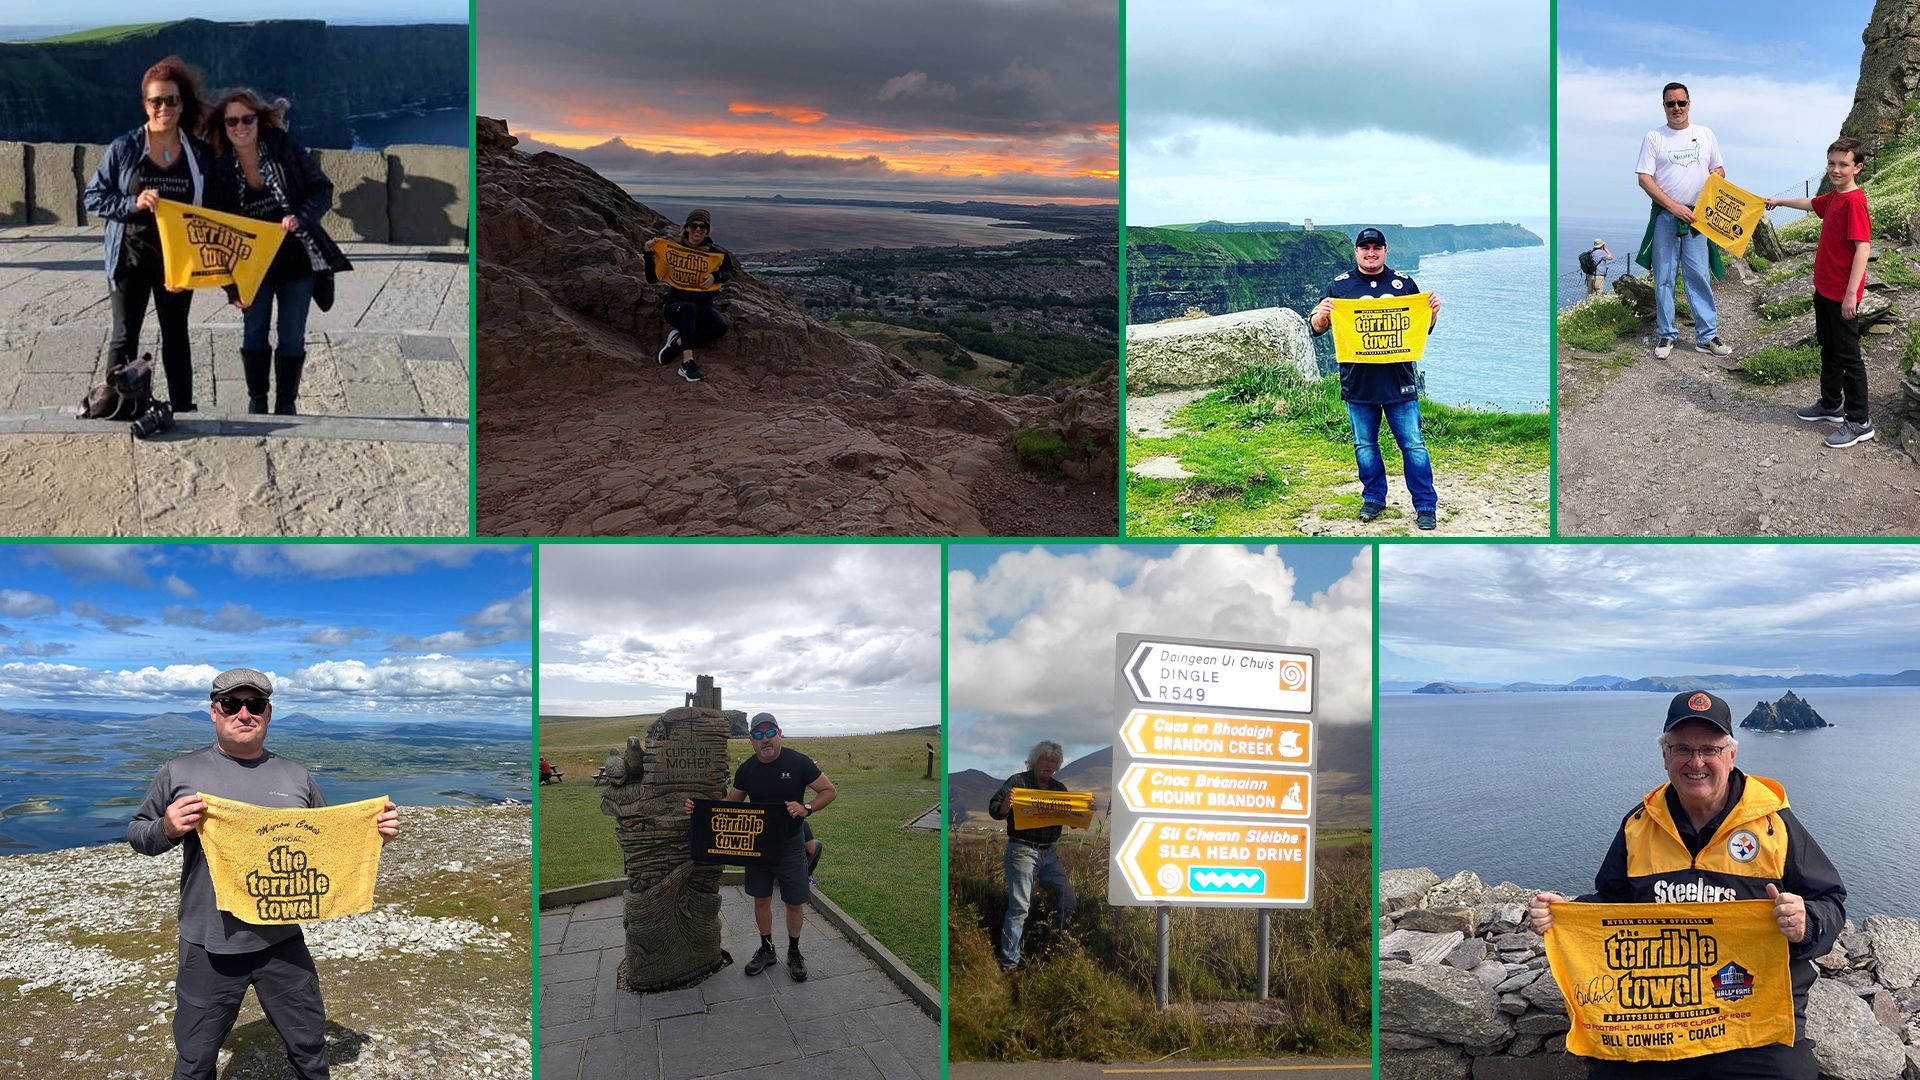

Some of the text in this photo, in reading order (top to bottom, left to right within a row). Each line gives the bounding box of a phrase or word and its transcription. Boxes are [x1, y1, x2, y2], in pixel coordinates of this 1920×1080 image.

[666, 250, 709, 273] terrible
[1355, 313, 1410, 334] terrible
[1362, 329, 1403, 350] towel
[1160, 650, 1217, 666] Daingean
[1160, 668, 1220, 683] DINGLE
[1153, 718, 1273, 740] Cuas an Bhodaigh
[666, 747, 711, 758] CLIFFS OF
[1154, 736, 1274, 756] BRANDON CREEK
[666, 757, 711, 769] MOHER
[1151, 771, 1190, 787] Cnoc
[1151, 790, 1275, 808] MOUNT BRANDON
[712, 814, 764, 834] terrible
[716, 832, 754, 851] towel
[1185, 828, 1240, 842] Cheann
[1245, 830, 1299, 844] Sléibhe
[268, 845, 308, 874] the
[1159, 844, 1302, 862] SLEA HEAD DRIVE
[246, 868, 330, 897] terrible
[1654, 878, 1736, 902] Steelers
[257, 894, 320, 921] towel
[1604, 929, 1718, 970] terrible
[1617, 967, 1703, 1009] towel
[1716, 989, 1732, 997] HALL
[1736, 987, 1752, 995] FAME
[1674, 1008, 1715, 1018] ORIGINAL
[1690, 1018, 1717, 1026] CLASS
[1601, 1034, 1622, 1047] BILL
[1626, 1032, 1674, 1047] COWHER
[1689, 1024, 1726, 1041] COACH
